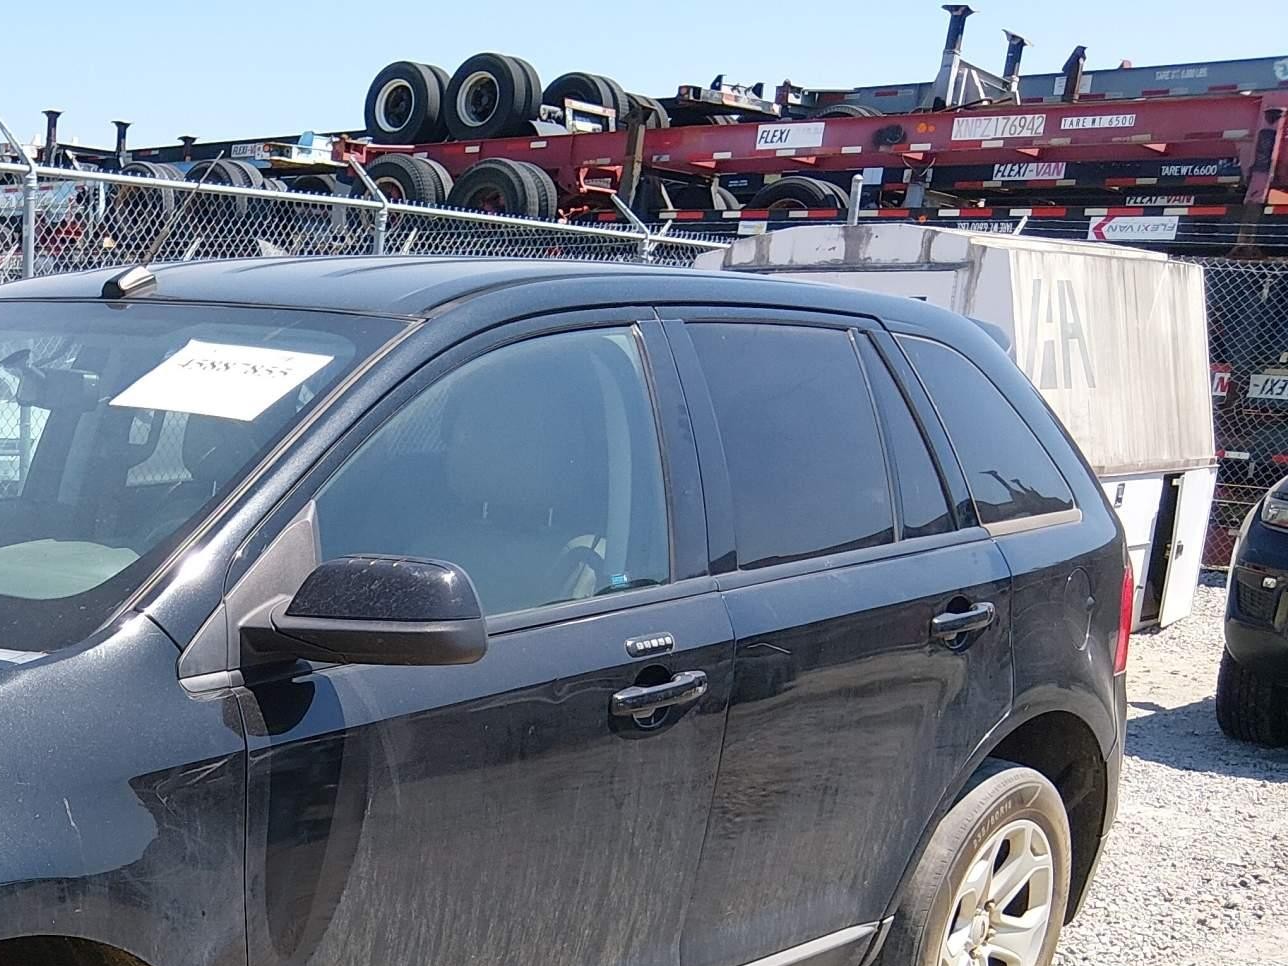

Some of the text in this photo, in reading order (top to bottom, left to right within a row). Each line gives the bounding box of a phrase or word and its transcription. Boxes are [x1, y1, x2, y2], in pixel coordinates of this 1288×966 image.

[1063, 117, 1088, 128] TARE
[1108, 115, 1134, 126] 6500
[757, 128, 791, 145] FLEXI
[994, 162, 1064, 178] FLEXI-VAN
